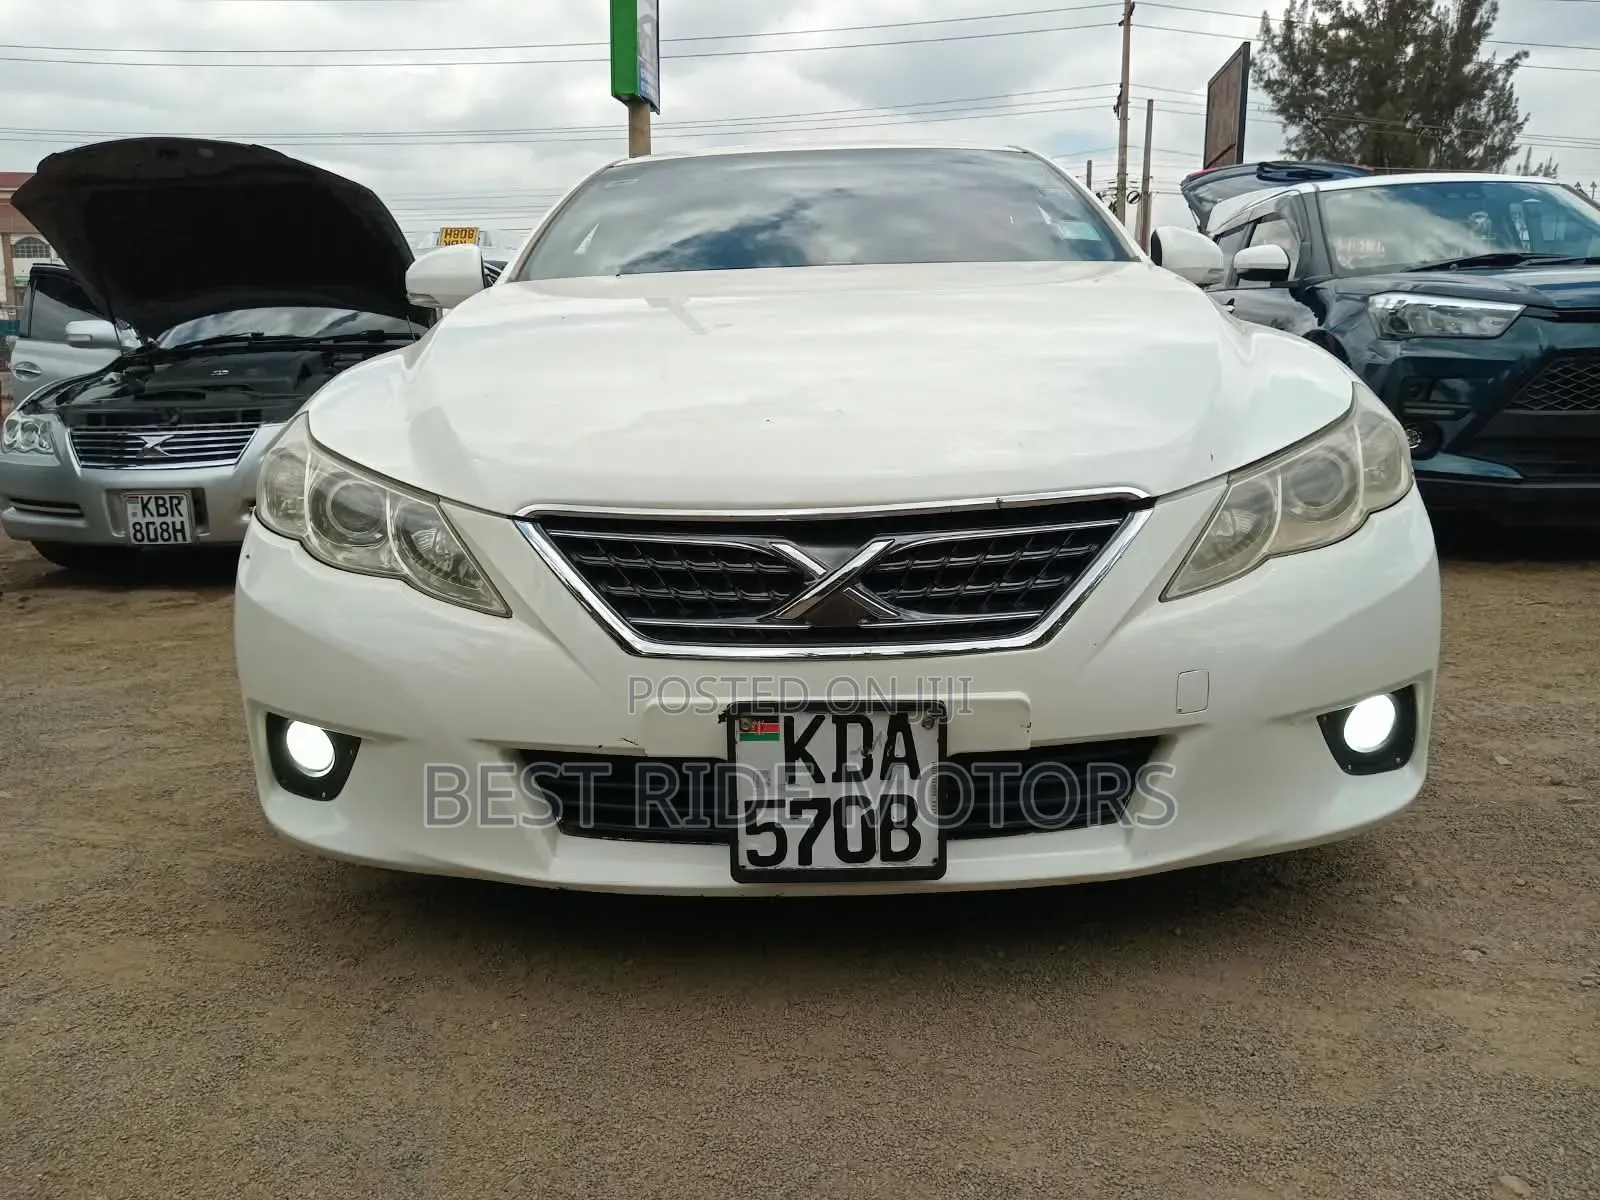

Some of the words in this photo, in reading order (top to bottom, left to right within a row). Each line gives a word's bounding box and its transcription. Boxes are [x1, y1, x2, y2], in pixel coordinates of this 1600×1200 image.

[140, 496, 184, 517] KBR
[132, 521, 187, 542] 808H
[744, 793, 922, 867] 570B
